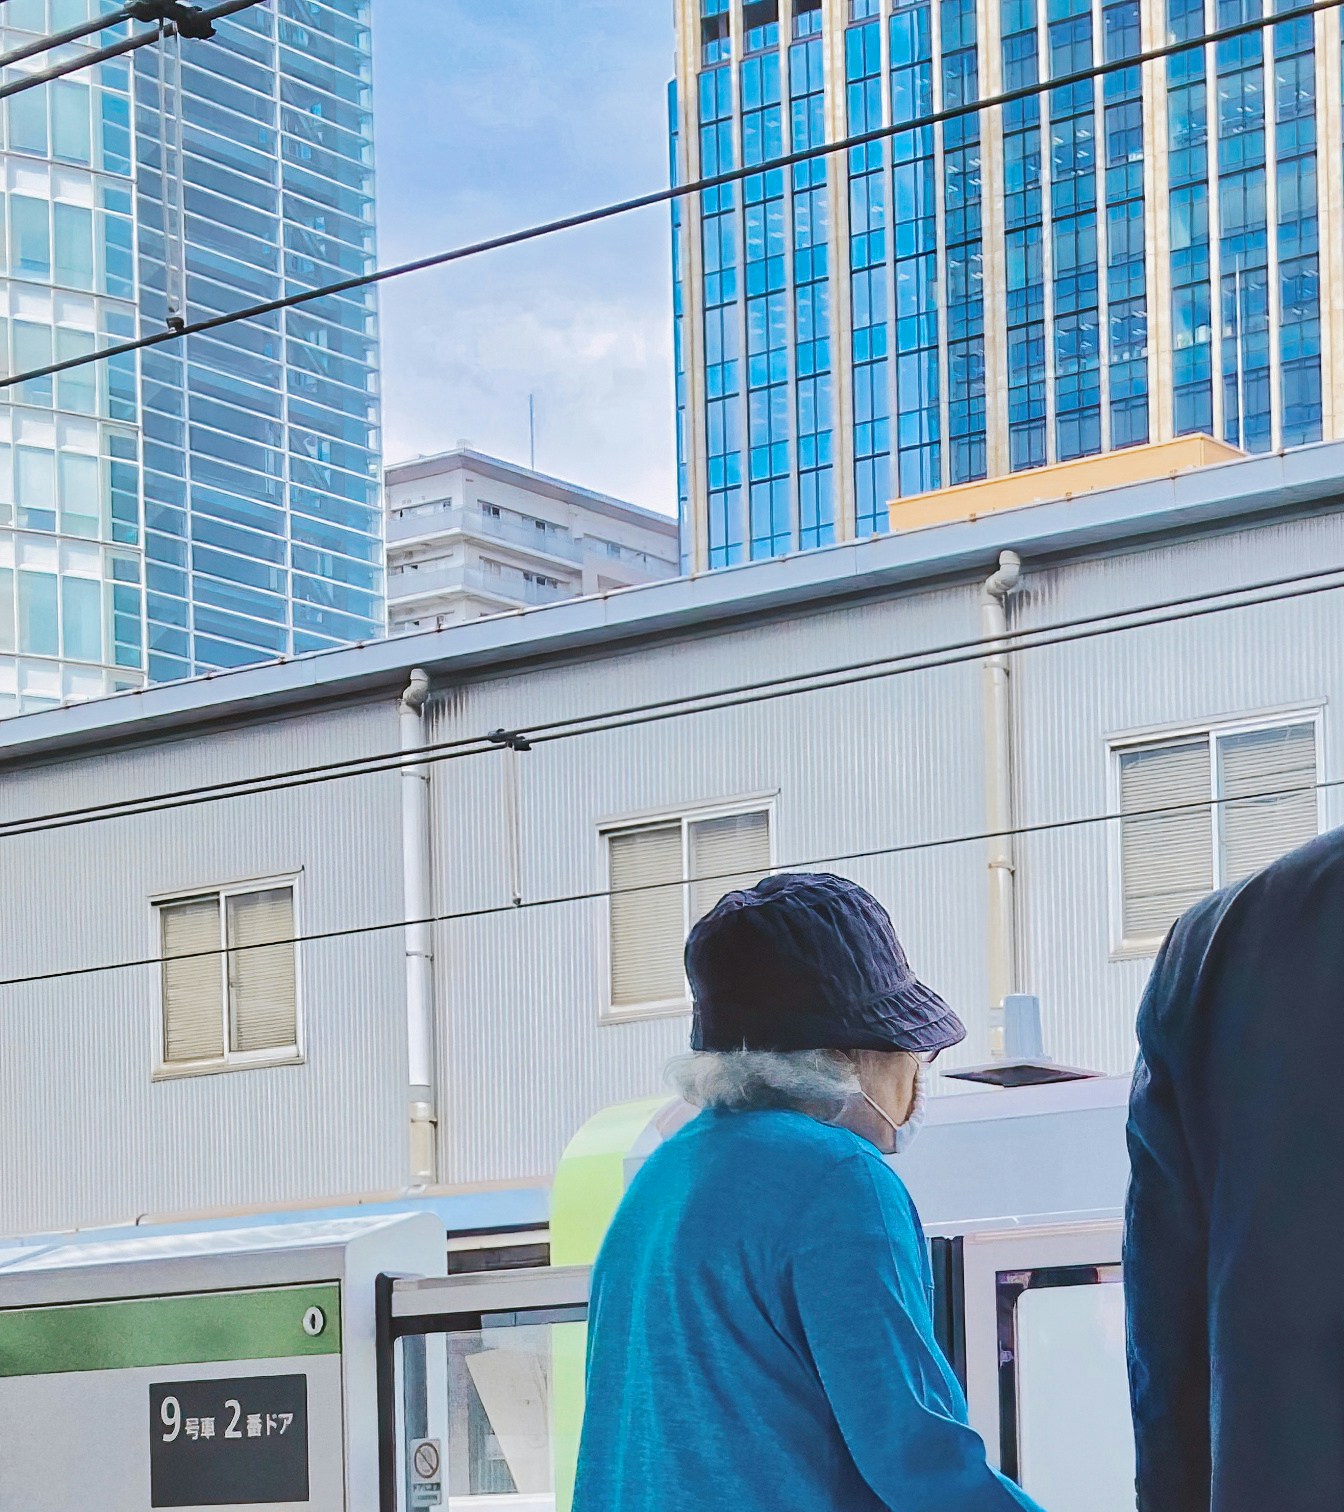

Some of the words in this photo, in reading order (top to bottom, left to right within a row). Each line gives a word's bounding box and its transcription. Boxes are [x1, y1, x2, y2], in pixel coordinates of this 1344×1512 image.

[160, 1396, 215, 1442] 9号車
[224, 1399, 294, 1439] 2番ドア
